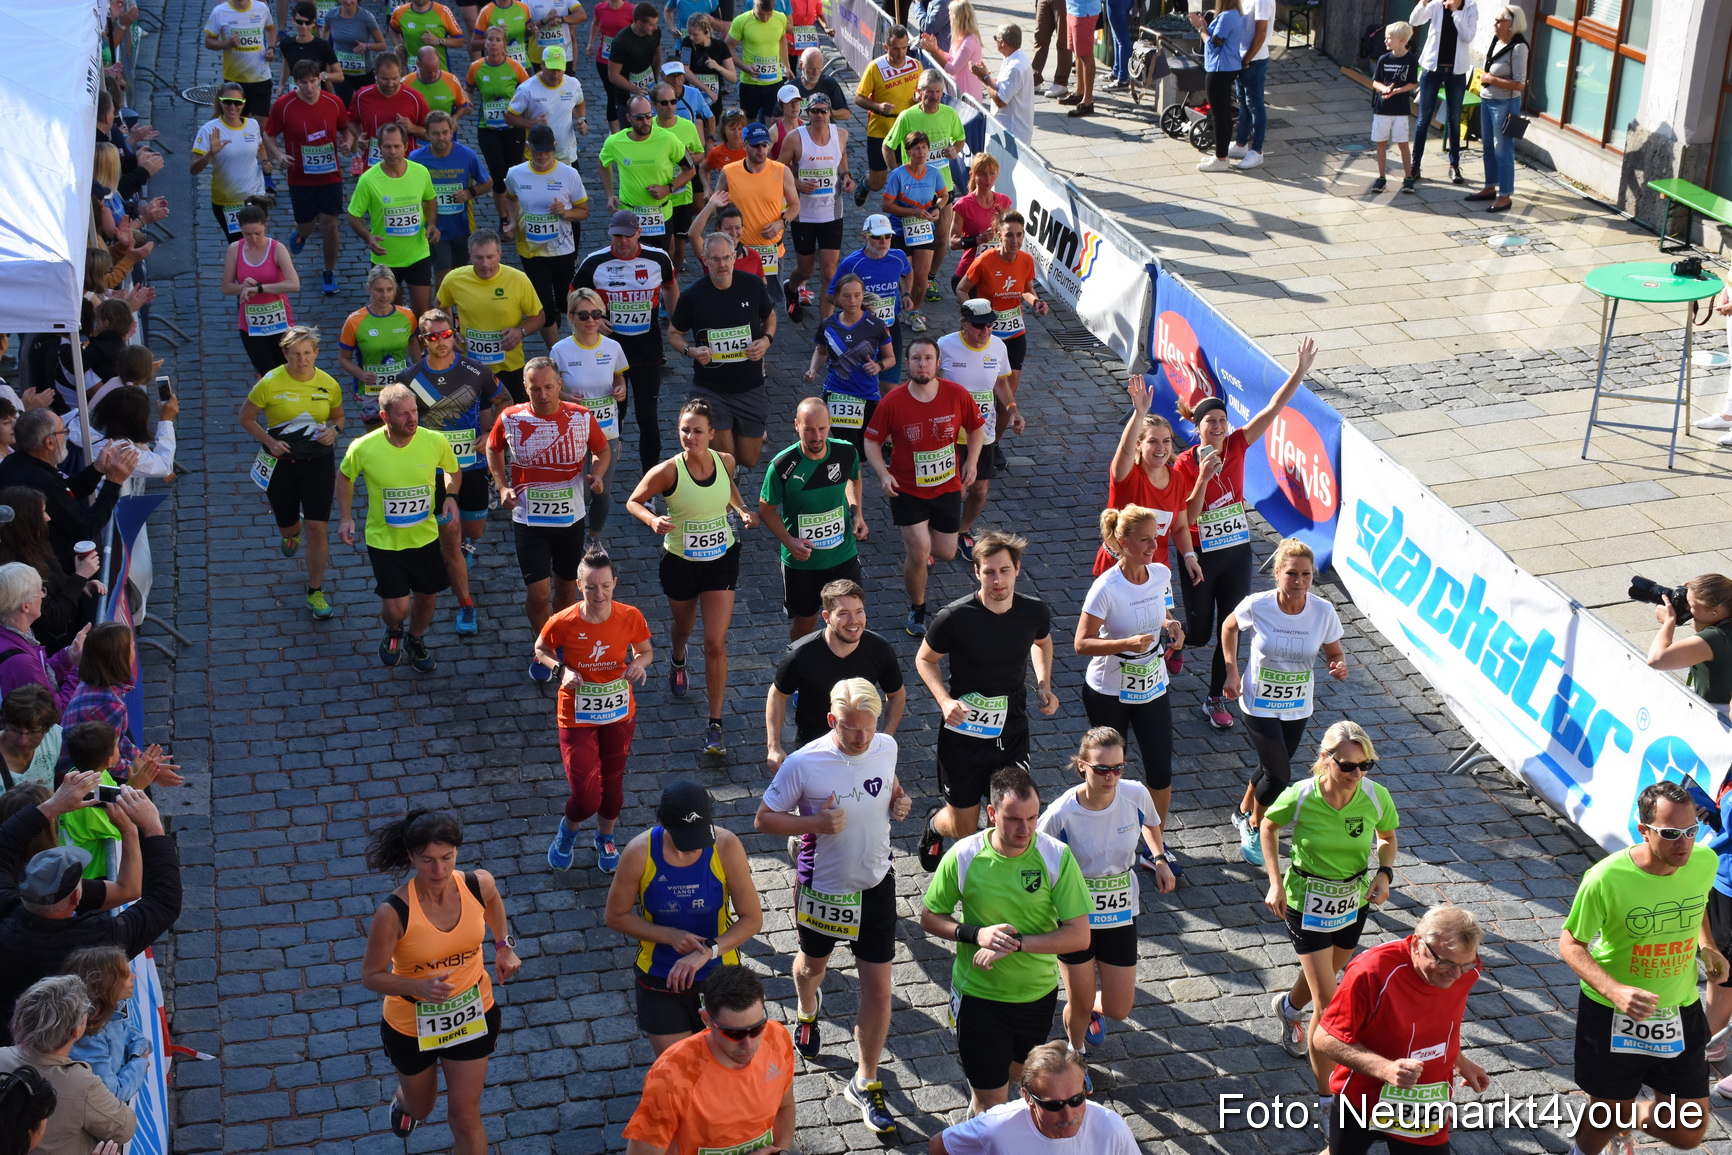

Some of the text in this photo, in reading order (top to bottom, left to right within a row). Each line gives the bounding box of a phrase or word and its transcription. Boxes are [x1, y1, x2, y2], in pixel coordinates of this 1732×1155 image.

[540, 30, 561, 39] 2045
[797, 33, 816, 42] 2196
[241, 37, 259, 46] 064
[340, 60, 362, 69] 1257
[755, 64, 775, 74] 2675
[885, 80, 903, 90] MAX
[488, 111, 506, 120] 271
[304, 145, 333, 154] BOCK
[306, 156, 332, 165] 2579
[801, 169, 831, 177] BOCK
[385, 205, 419, 215] BOCK
[389, 216, 418, 227] 2236
[526, 214, 557, 222] BOCK
[528, 223, 555, 234] 2811
[907, 225, 931, 236] 2459
[1026, 199, 1079, 270] swn
[865, 281, 898, 293] SYSCAD
[1053, 266, 1083, 302] neumarkt
[247, 301, 282, 314] BOCK
[614, 303, 648, 311] BOCK
[251, 312, 283, 326] 2221
[615, 313, 647, 325] 2747
[992, 319, 1020, 331] 2738
[468, 330, 502, 340] BOCK
[711, 327, 747, 340] BOCK
[470, 340, 500, 353] 2063
[715, 338, 748, 352] 1145
[722, 351, 744, 359] ANDRÉ
[1158, 317, 1214, 398] Hervis
[368, 364, 402, 373] BOCK
[466, 363, 482, 376] GROH
[1220, 368, 1245, 392] STORE
[830, 393, 865, 402] BOCK
[831, 404, 862, 416] 1334
[1228, 393, 1251, 422] ONLINE
[832, 417, 859, 425] VANESSA
[918, 444, 955, 462] BOCK
[921, 457, 953, 475] 1116
[1270, 413, 1333, 508] Hervis
[386, 487, 425, 499] BOCK
[530, 489, 570, 499] BOCK
[389, 499, 426, 515] 2727
[532, 501, 570, 516] 2725
[688, 518, 725, 532] BOCK
[802, 511, 842, 526] BOCK
[805, 521, 841, 540] 2659
[1204, 519, 1242, 538] 2564
[690, 531, 725, 549] 2658
[1208, 534, 1244, 548] RAPHAEL
[692, 547, 722, 558] BETTINA
[577, 660, 617, 669] funrunners
[1126, 660, 1160, 676] BOCK
[1127, 671, 1160, 690] 2157
[1263, 669, 1307, 683] BOCK
[580, 682, 624, 696] BOCK
[1127, 686, 1160, 700] KRISTINA
[1261, 684, 1302, 699] 2551
[582, 694, 624, 711] 2343
[966, 691, 1005, 709] BOCK
[1265, 700, 1296, 708] JUDITH
[590, 711, 617, 721] KARIN
[968, 709, 1001, 726] 341
[966, 725, 983, 734] JAN
[869, 781, 881, 794] IT
[1312, 882, 1358, 897] BOCK
[692, 898, 705, 909] FR
[1094, 891, 1128, 911] 545
[1311, 896, 1356, 915] 2484
[806, 901, 854, 923] 1139
[1094, 914, 1118, 924] ROSA
[1319, 916, 1348, 927] HEIKE
[806, 917, 850, 936] ANDREAS
[1631, 936, 1695, 957] MERZ
[1630, 952, 1694, 969] PREMIUM
[422, 989, 476, 1015] BOCK
[426, 1005, 478, 1033] 1303
[438, 1026, 468, 1045] IRENE
[1621, 1018, 1676, 1041] 2065
[1623, 1038, 1675, 1053] MICHAEL
[1388, 1084, 1442, 1100] BOCK
